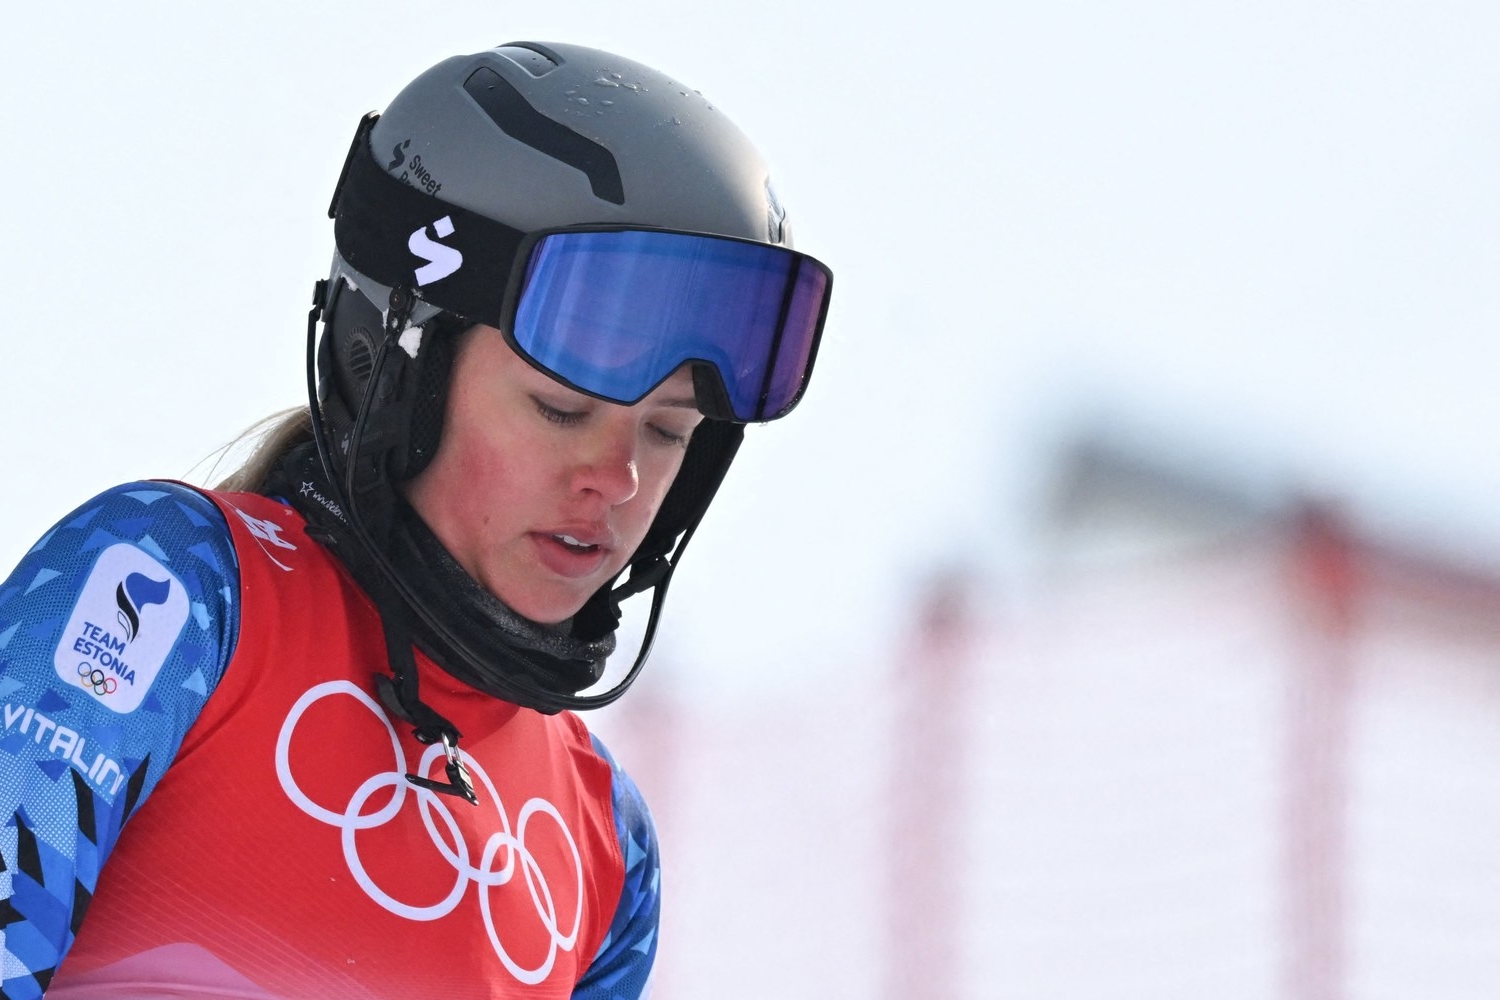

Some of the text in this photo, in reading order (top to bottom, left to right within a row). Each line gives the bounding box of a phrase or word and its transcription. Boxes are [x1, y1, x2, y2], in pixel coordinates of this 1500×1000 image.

[409, 154, 442, 198] Sweet
[82, 621, 126, 656] TEAM
[73, 637, 136, 686] ESTONIA
